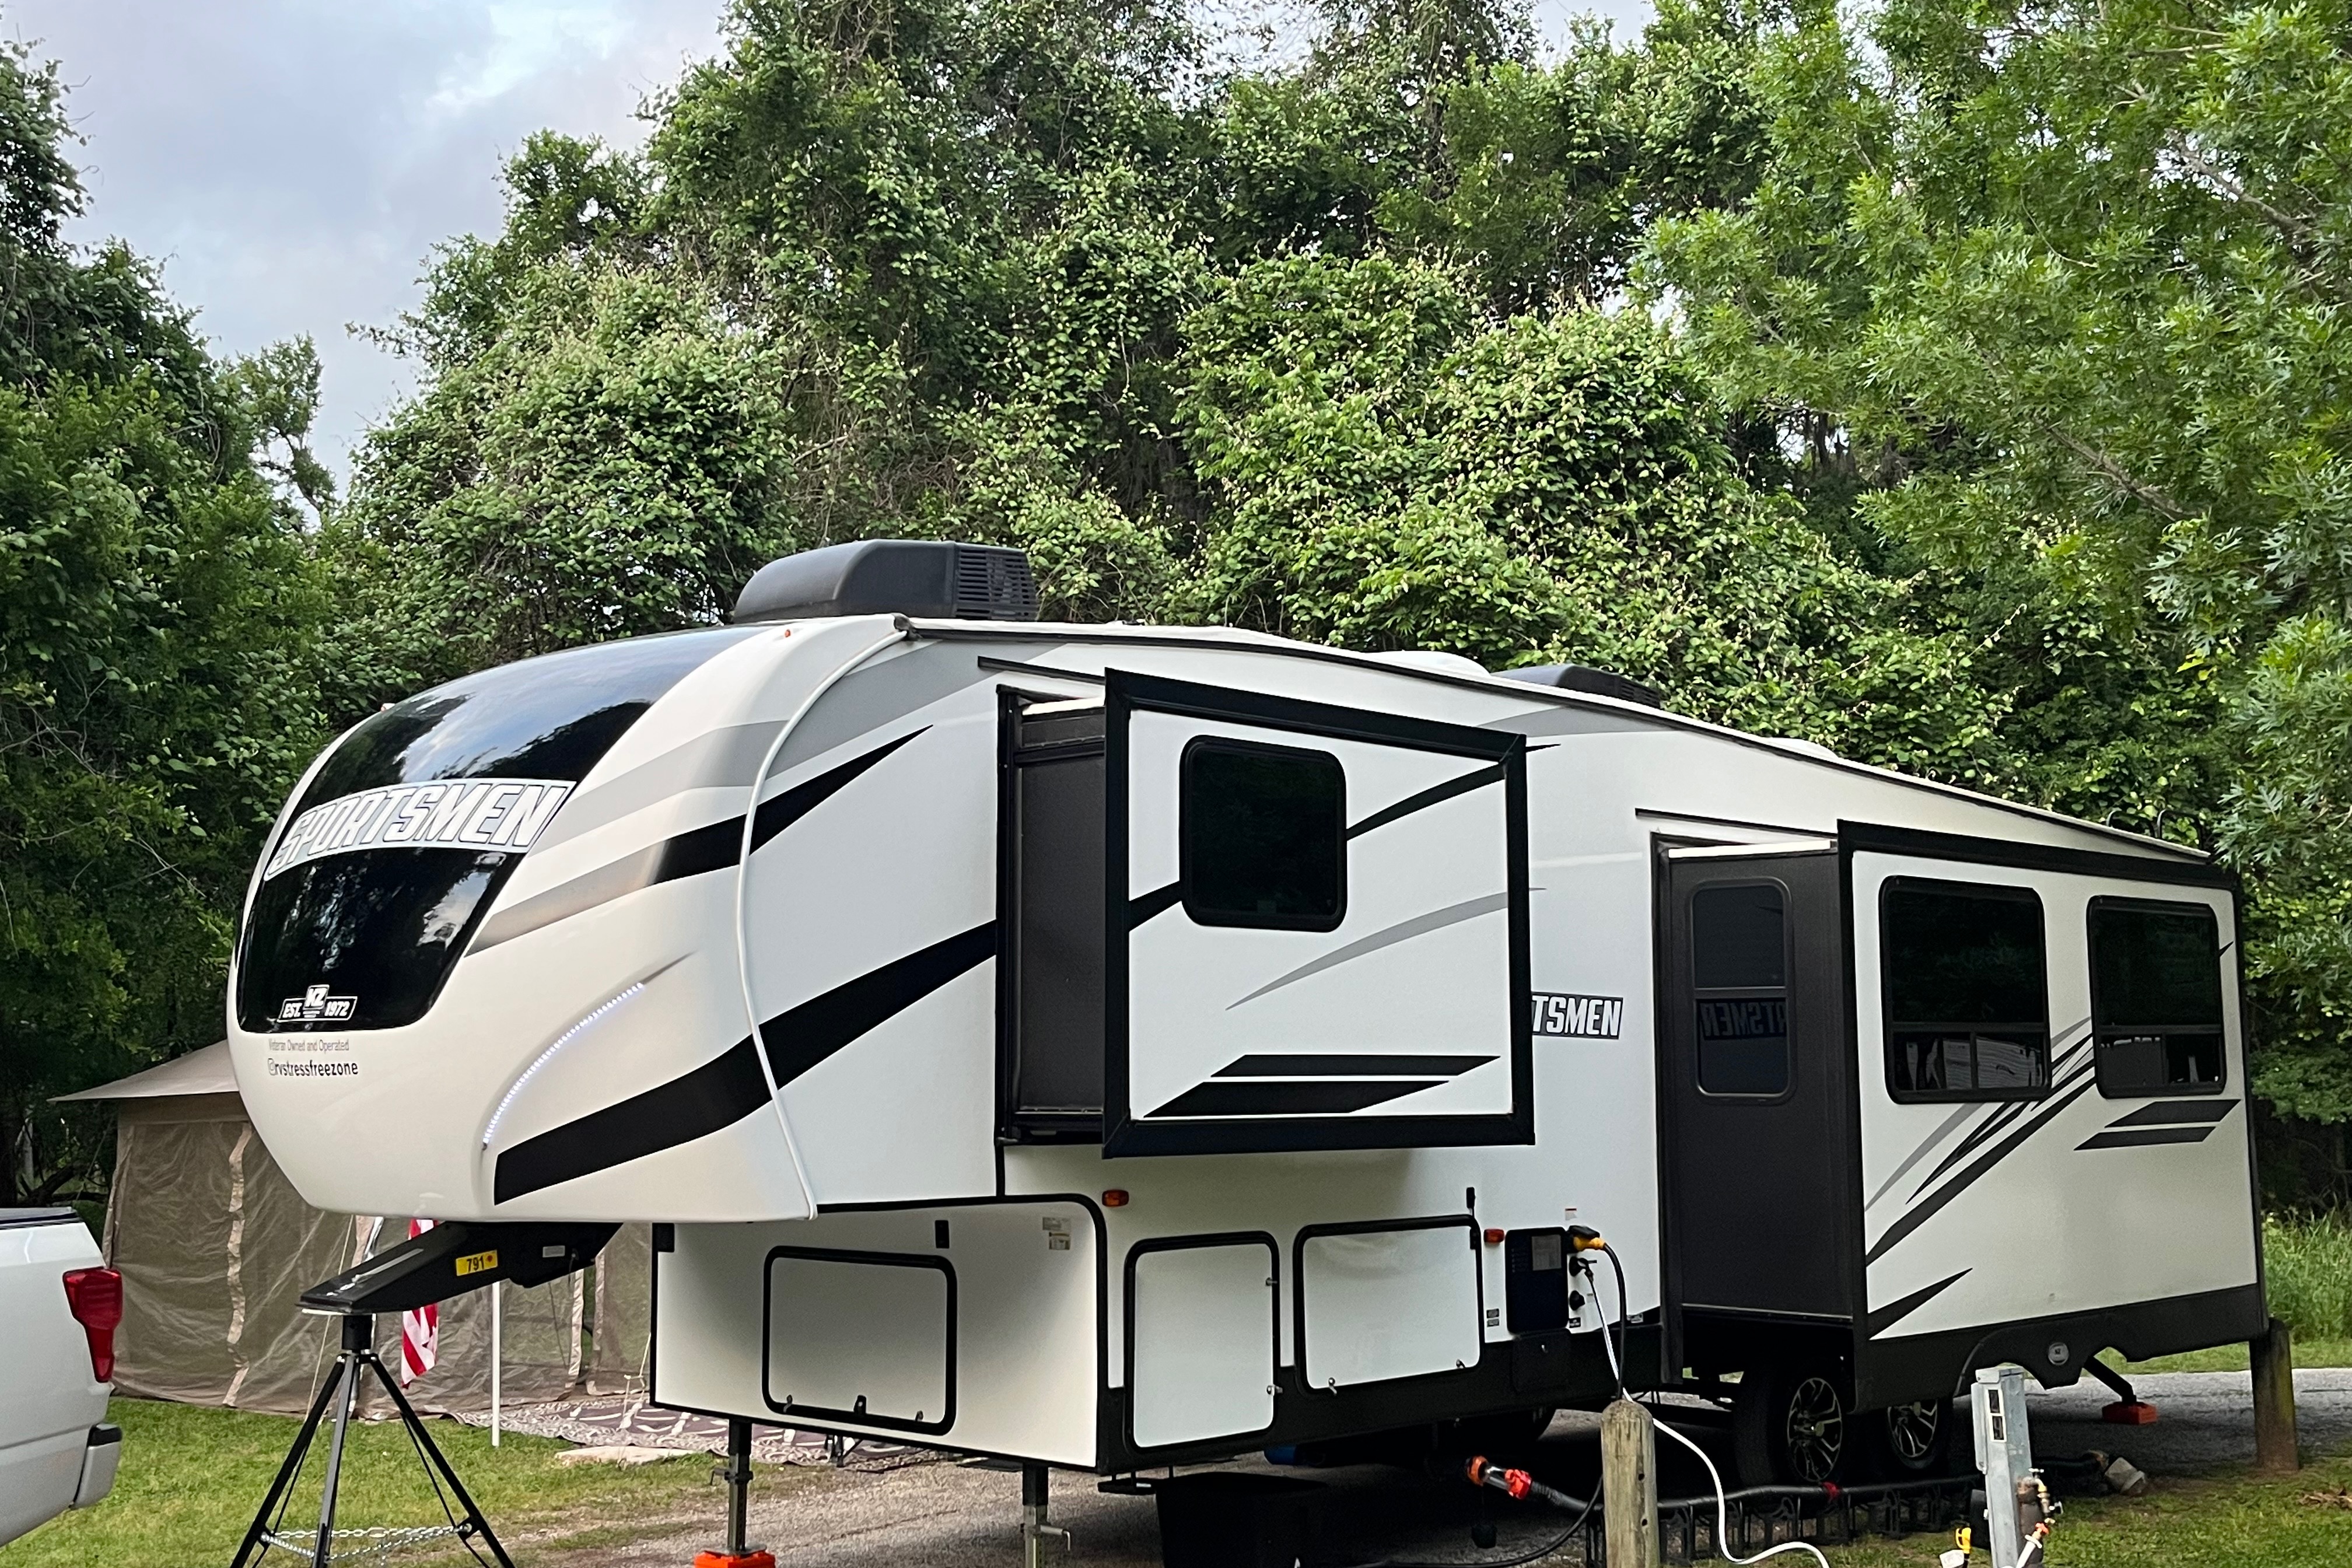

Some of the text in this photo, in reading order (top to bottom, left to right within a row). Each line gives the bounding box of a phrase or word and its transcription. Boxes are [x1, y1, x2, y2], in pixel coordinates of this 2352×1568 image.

[266, 782, 569, 876] SPORTSMEN
[324, 1001, 350, 1016] 1972
[1532, 995, 1621, 1036] TSMEN
[287, 1039, 305, 1051] Owned
[307, 1039, 317, 1051] and
[319, 1039, 349, 1054] Operated
[267, 1058, 359, 1076] @rvstressfreezone
[467, 1255, 485, 1272] 791
